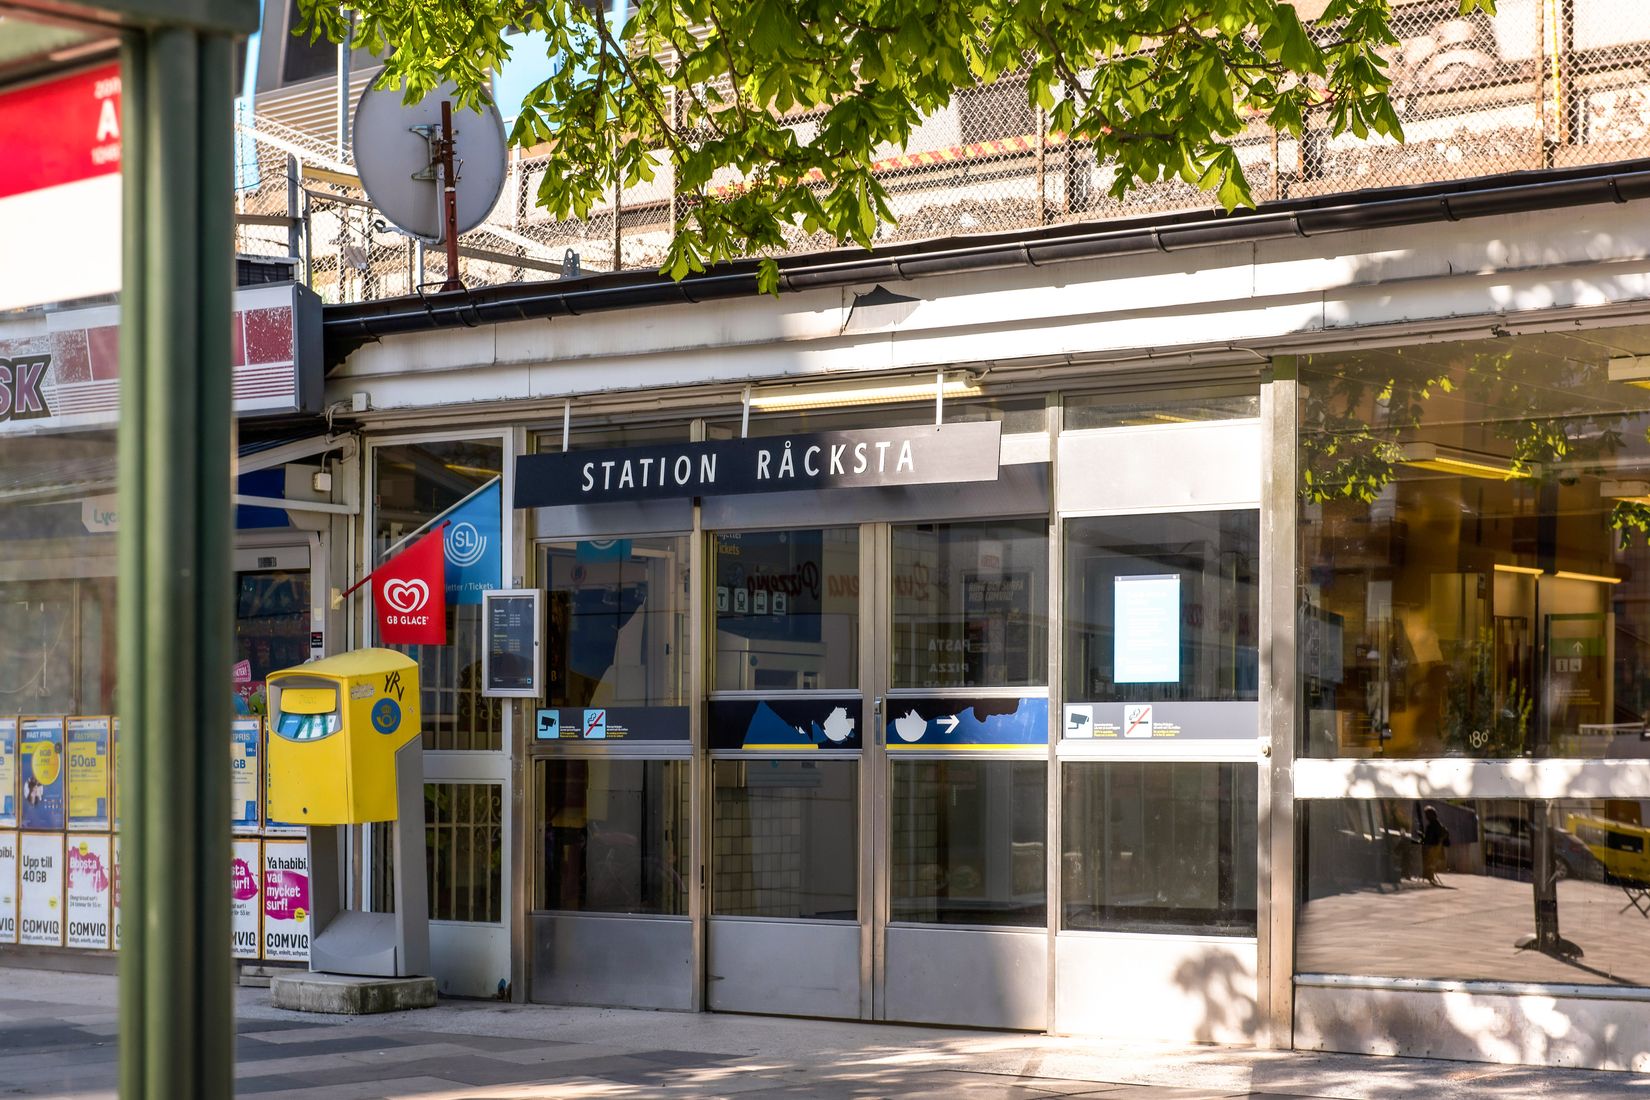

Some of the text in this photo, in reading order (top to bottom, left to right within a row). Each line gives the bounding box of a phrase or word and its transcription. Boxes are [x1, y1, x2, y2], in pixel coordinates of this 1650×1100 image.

[582, 440, 914, 492] STATION RÅCKSTA
[93, 507, 119, 527] Lyc
[455, 531, 474, 547] SL
[469, 582, 494, 591] Tickets
[387, 616, 398, 625] GB
[23, 855, 52, 869] Upp till
[267, 857, 309, 871] Ya habibi,
[267, 872, 283, 883] vad
[267, 885, 301, 899] mycket
[267, 898, 288, 911] surf!
[23, 919, 59, 934] COMVIQ
[69, 921, 106, 937] COMVIQ
[267, 933, 309, 949] COMVIQ
